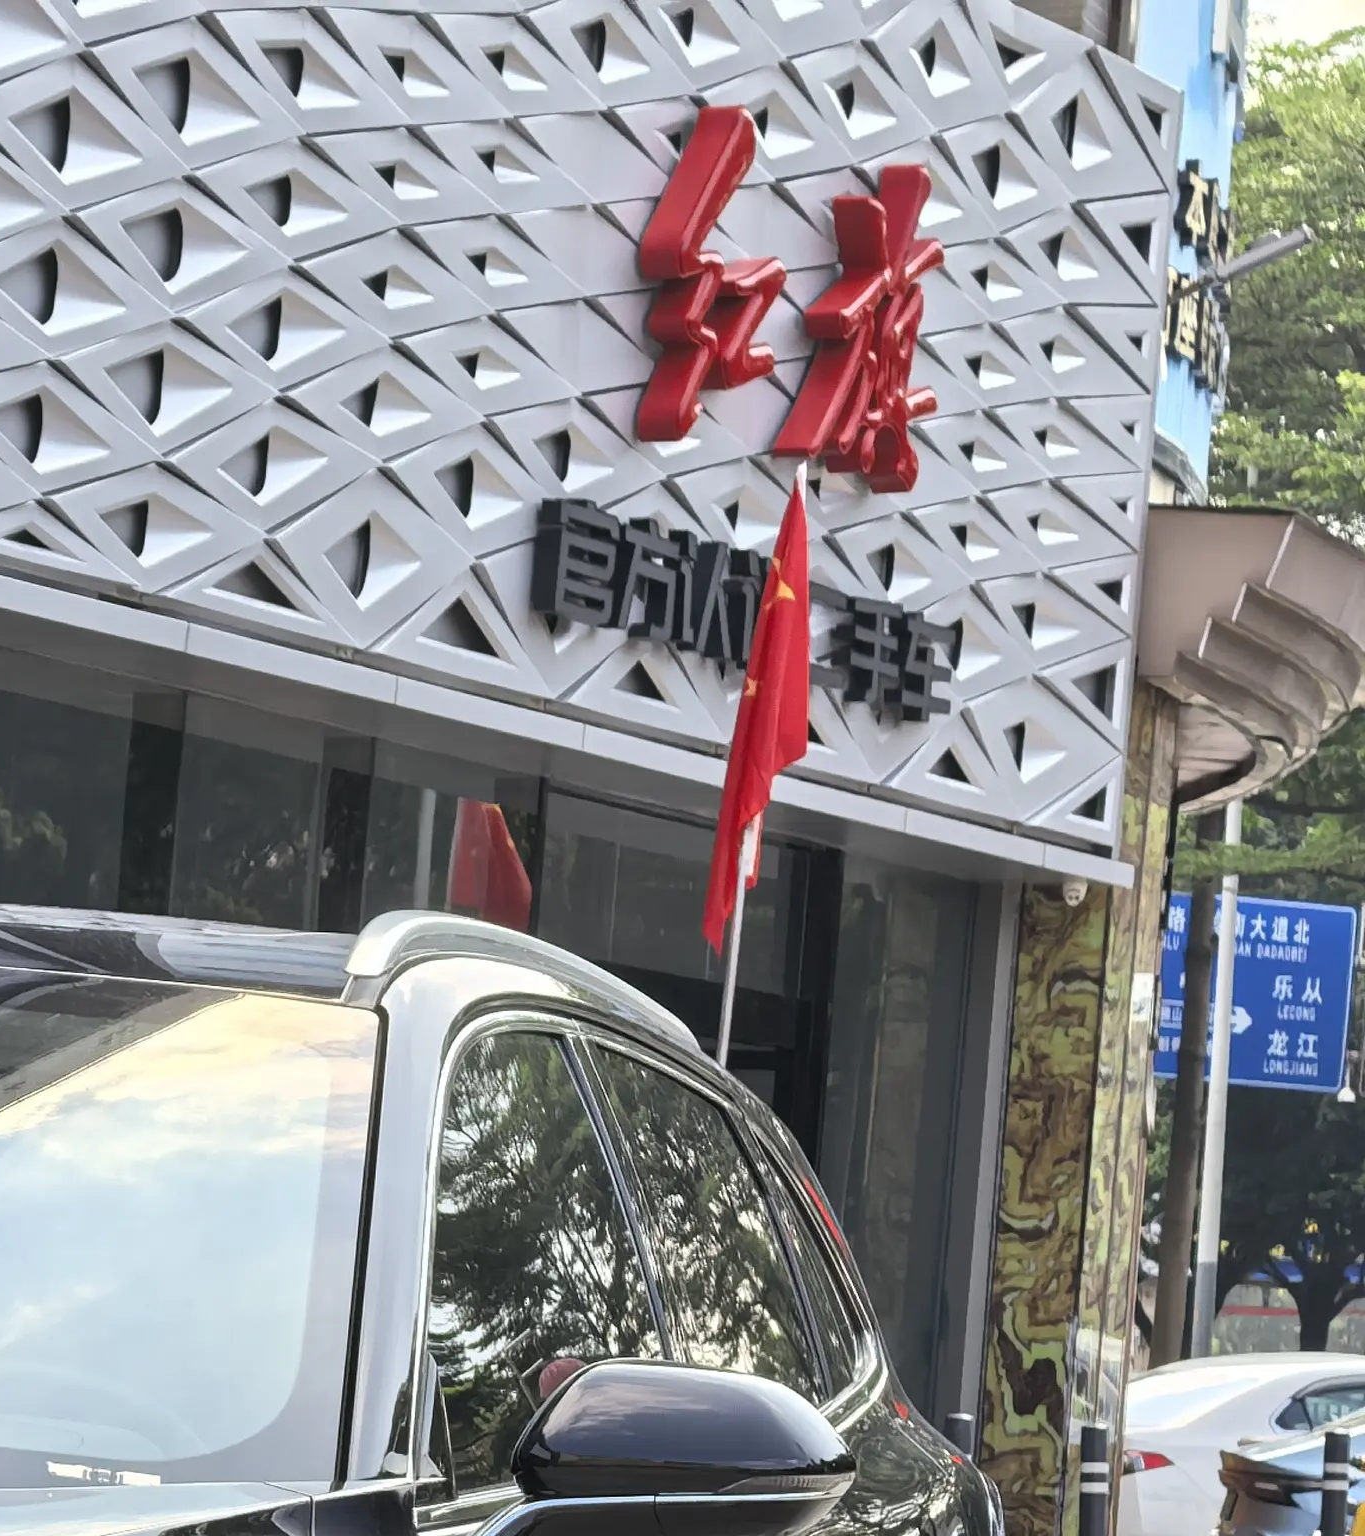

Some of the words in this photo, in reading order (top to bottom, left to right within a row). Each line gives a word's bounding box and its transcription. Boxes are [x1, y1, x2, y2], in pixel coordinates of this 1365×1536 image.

[637, 106, 945, 493] 红旗
[1214, 908, 1310, 945] 大道北
[1272, 974, 1323, 1004] 乐从
[1267, 1029, 1318, 1059] 龙江
